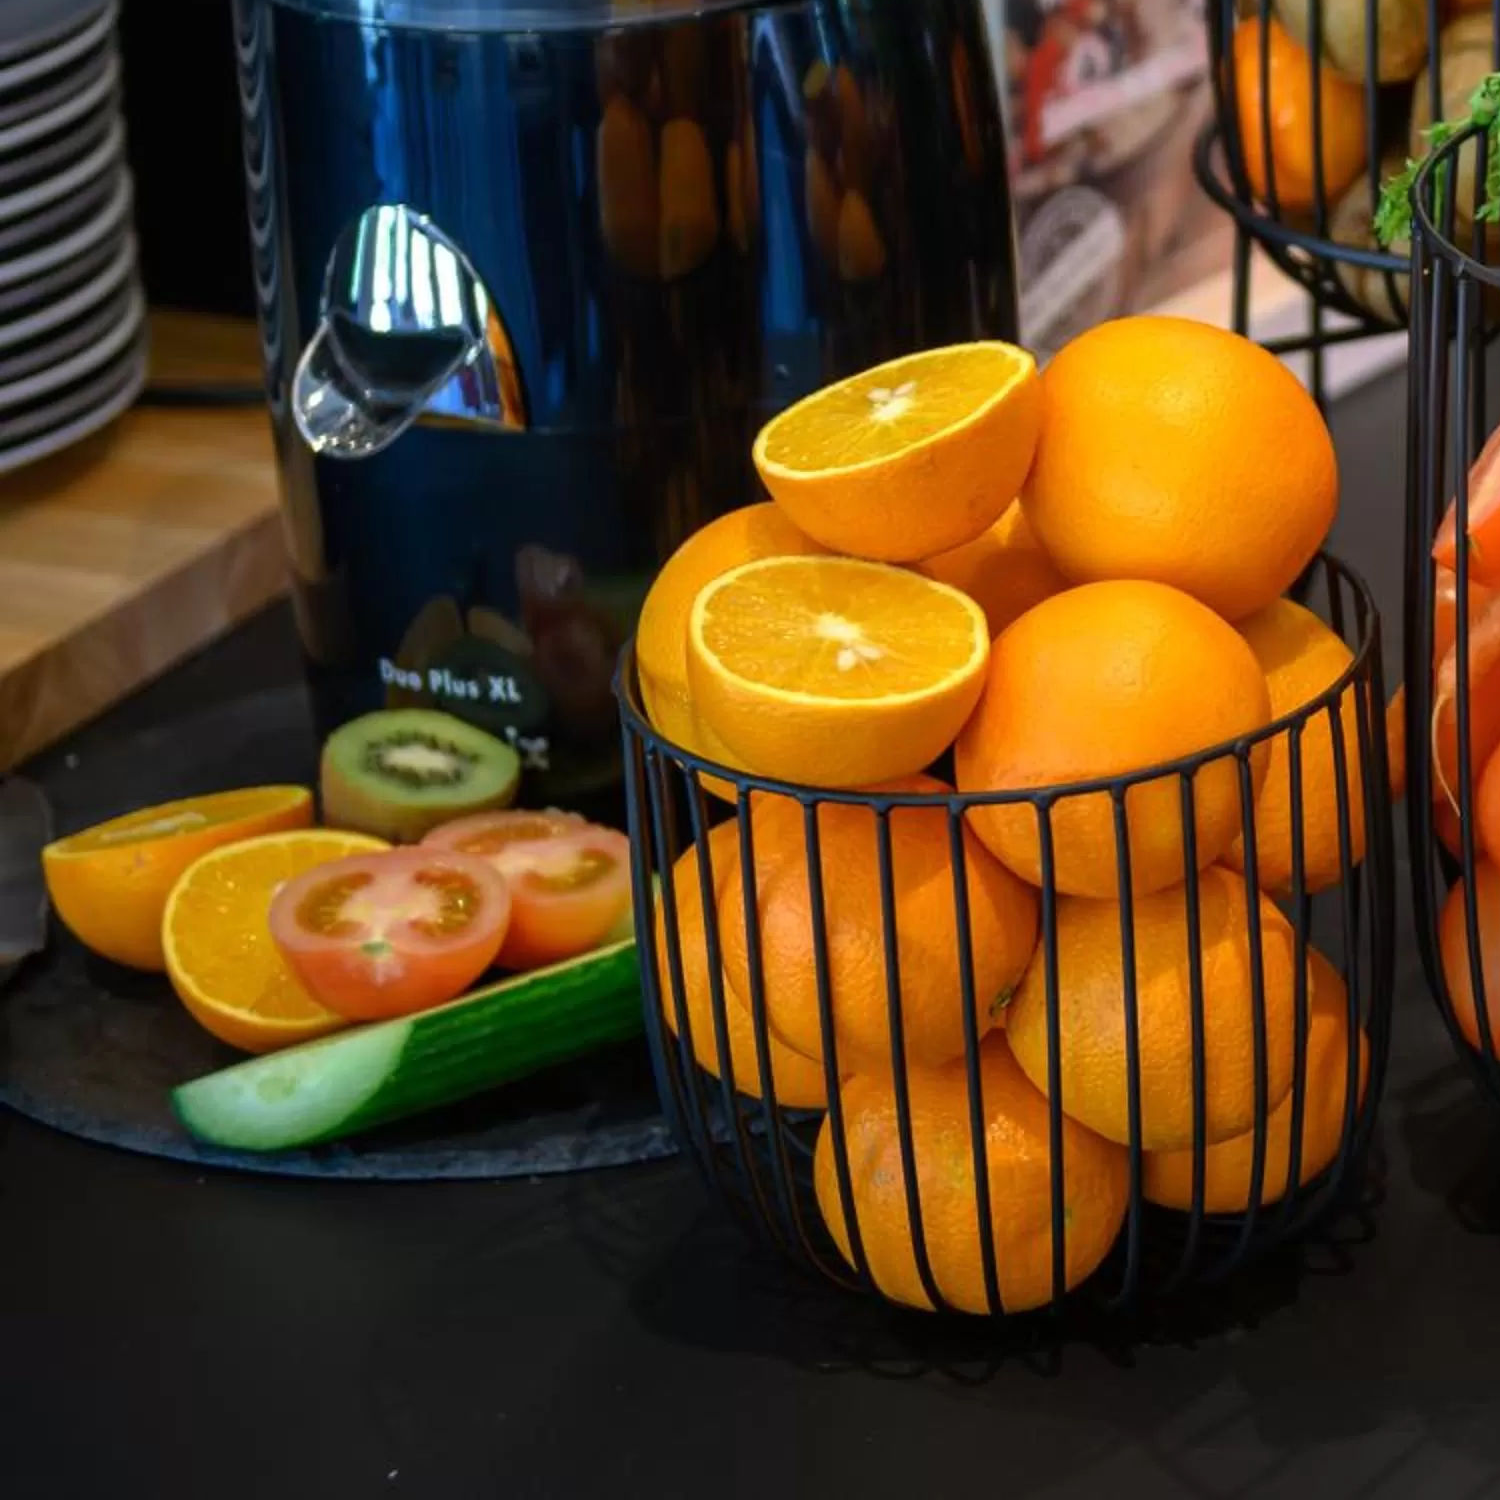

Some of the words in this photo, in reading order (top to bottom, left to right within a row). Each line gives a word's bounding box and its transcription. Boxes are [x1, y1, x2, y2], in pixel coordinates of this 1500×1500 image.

[378, 656, 423, 692] Duo
[428, 668, 480, 699] Plus
[488, 675, 522, 703] XL
